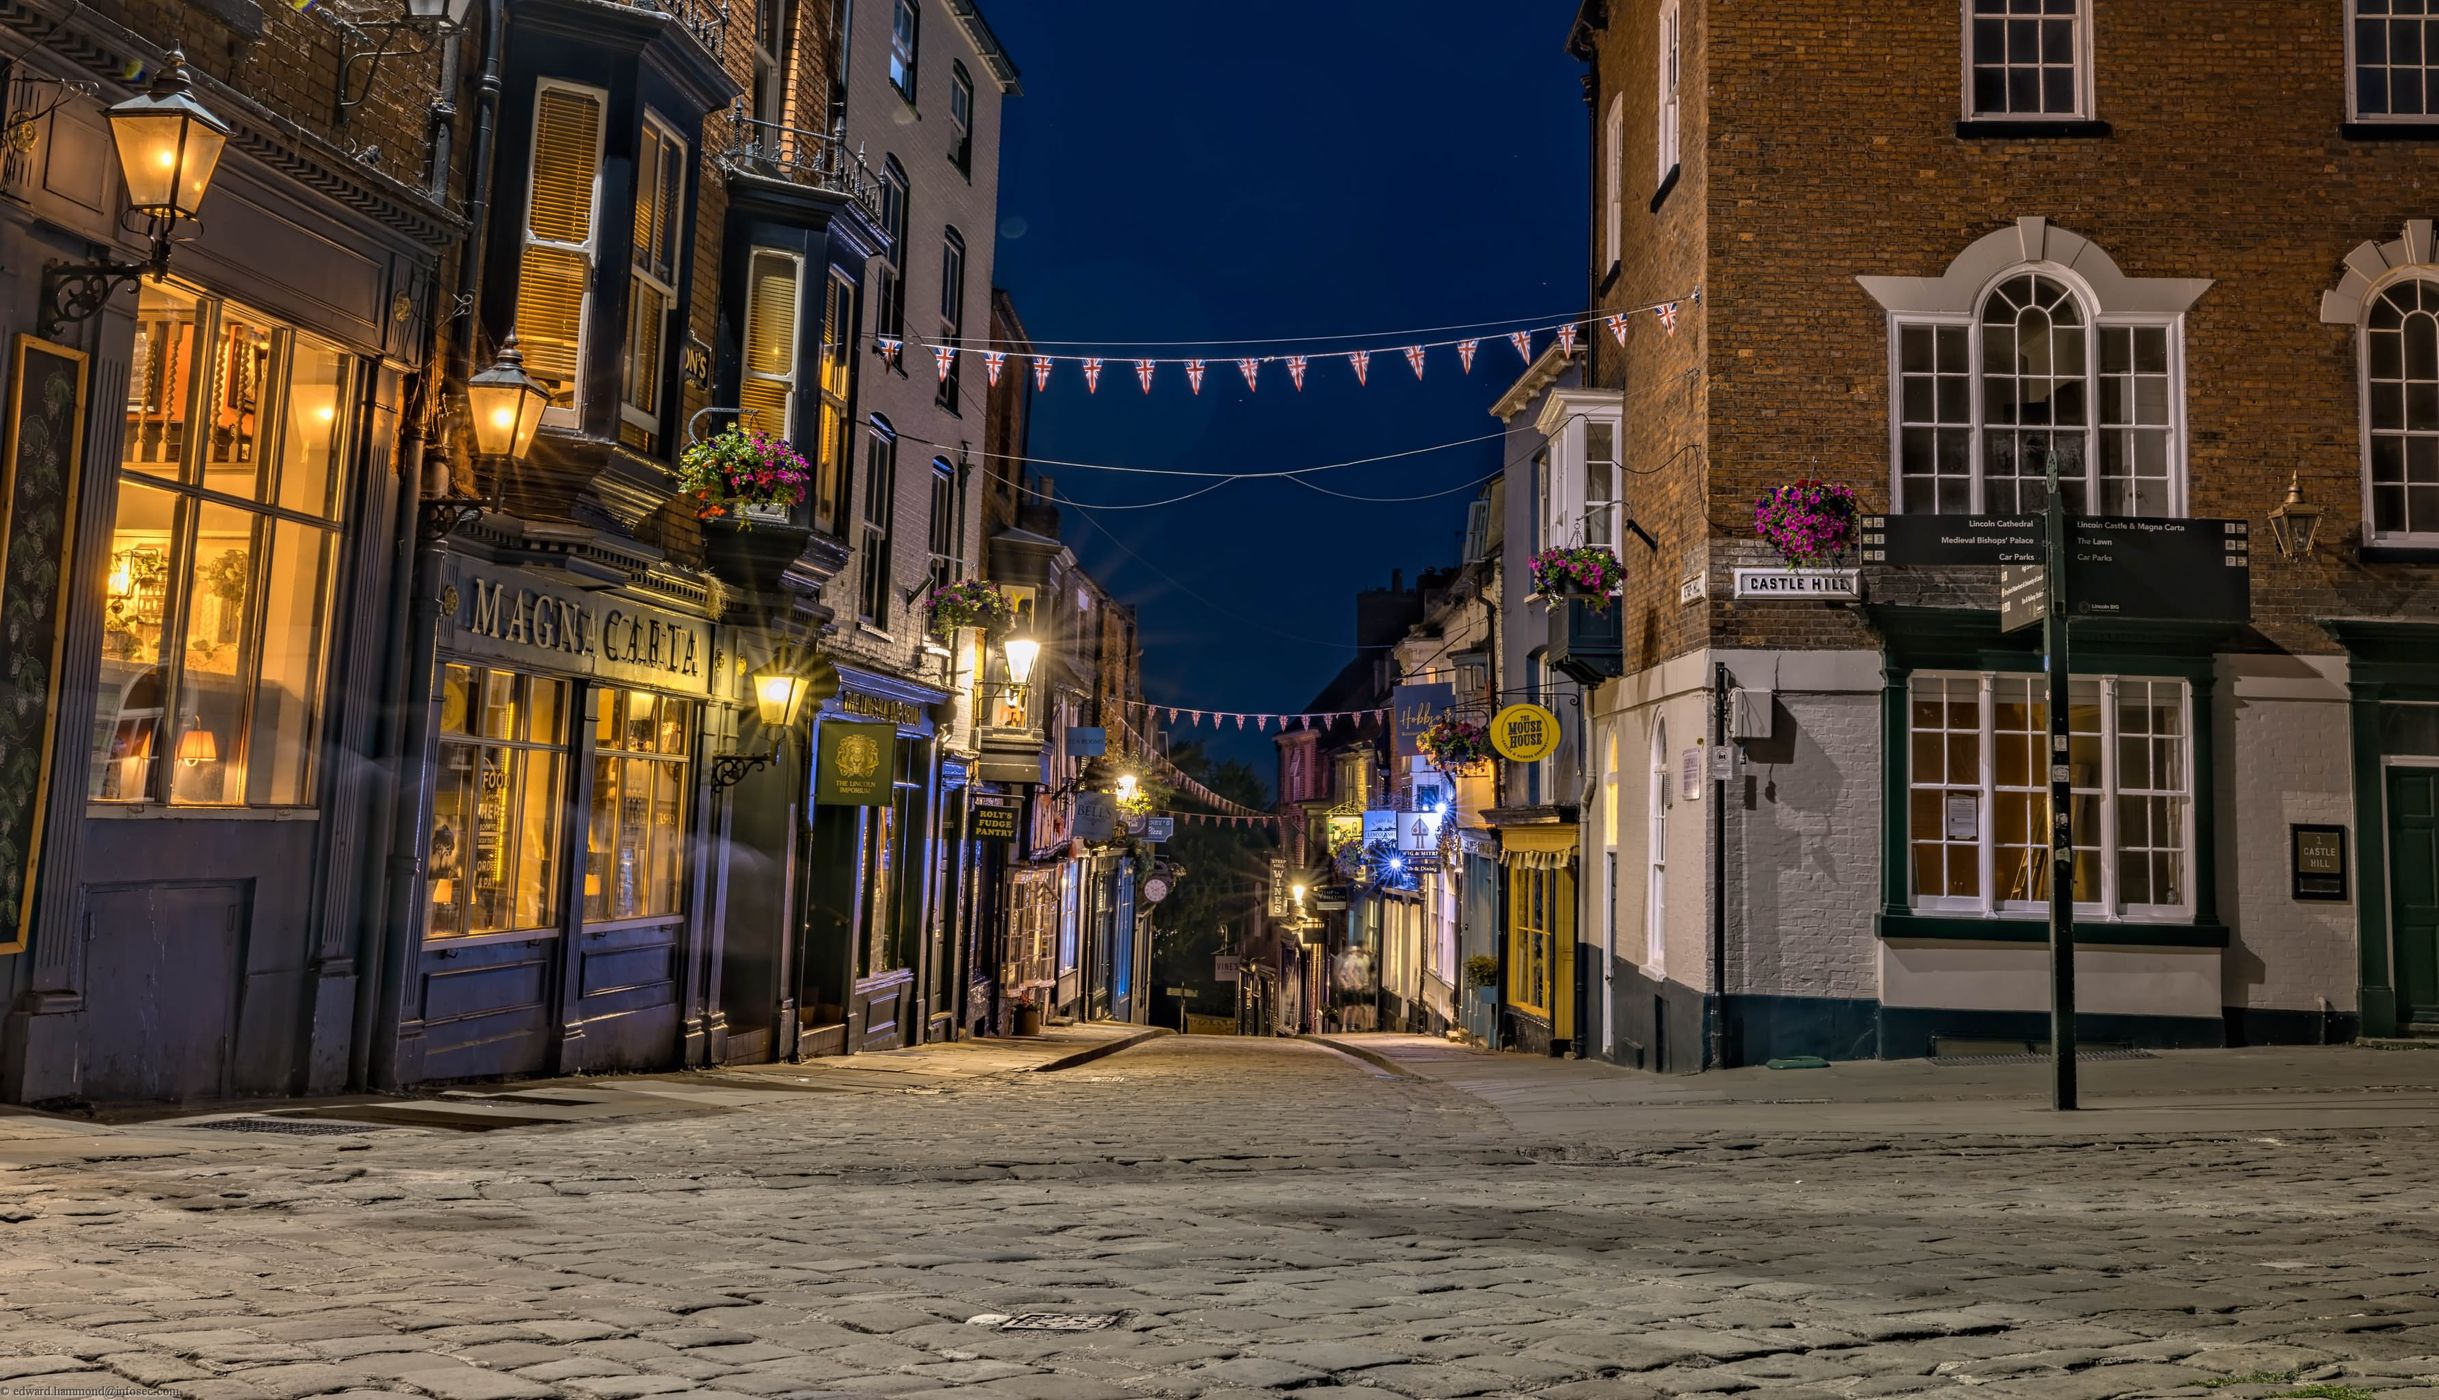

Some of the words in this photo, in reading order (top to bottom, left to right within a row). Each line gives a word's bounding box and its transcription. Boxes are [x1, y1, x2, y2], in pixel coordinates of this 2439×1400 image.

[1969, 520, 1996, 528] Lincoln
[1997, 520, 2034, 528] Cathedral
[2077, 521, 2103, 529] Lincoln
[2104, 522, 2128, 530] Castle
[2138, 523, 2163, 532] Magna
[1941, 536, 1976, 544] Medieval
[1977, 536, 2008, 546] Bishops'
[2009, 536, 2034, 545] Palace
[2077, 537, 2091, 545] The
[2092, 538, 2113, 546] Lawn
[1999, 553, 2012, 561] Car
[2014, 553, 2035, 561] Parks
[2092, 554, 2113, 562] Parks
[1750, 577, 1805, 590] CASTLE
[472, 579, 599, 658] MAGNA
[603, 610, 702, 677] CARTA
[1507, 720, 1542, 735] MOUSE
[1509, 733, 1543, 748] HOUSE
[482, 771, 511, 788] FOOD
[979, 810, 1013, 819] ROLY'S
[979, 819, 1012, 828] FUDGE
[975, 827, 1014, 837] PANTRY
[2316, 836, 2322, 845] 1
[2303, 847, 2336, 857] CASTLE
[2310, 859, 2330, 868] HILL
[1273, 870, 1284, 914] WINES
